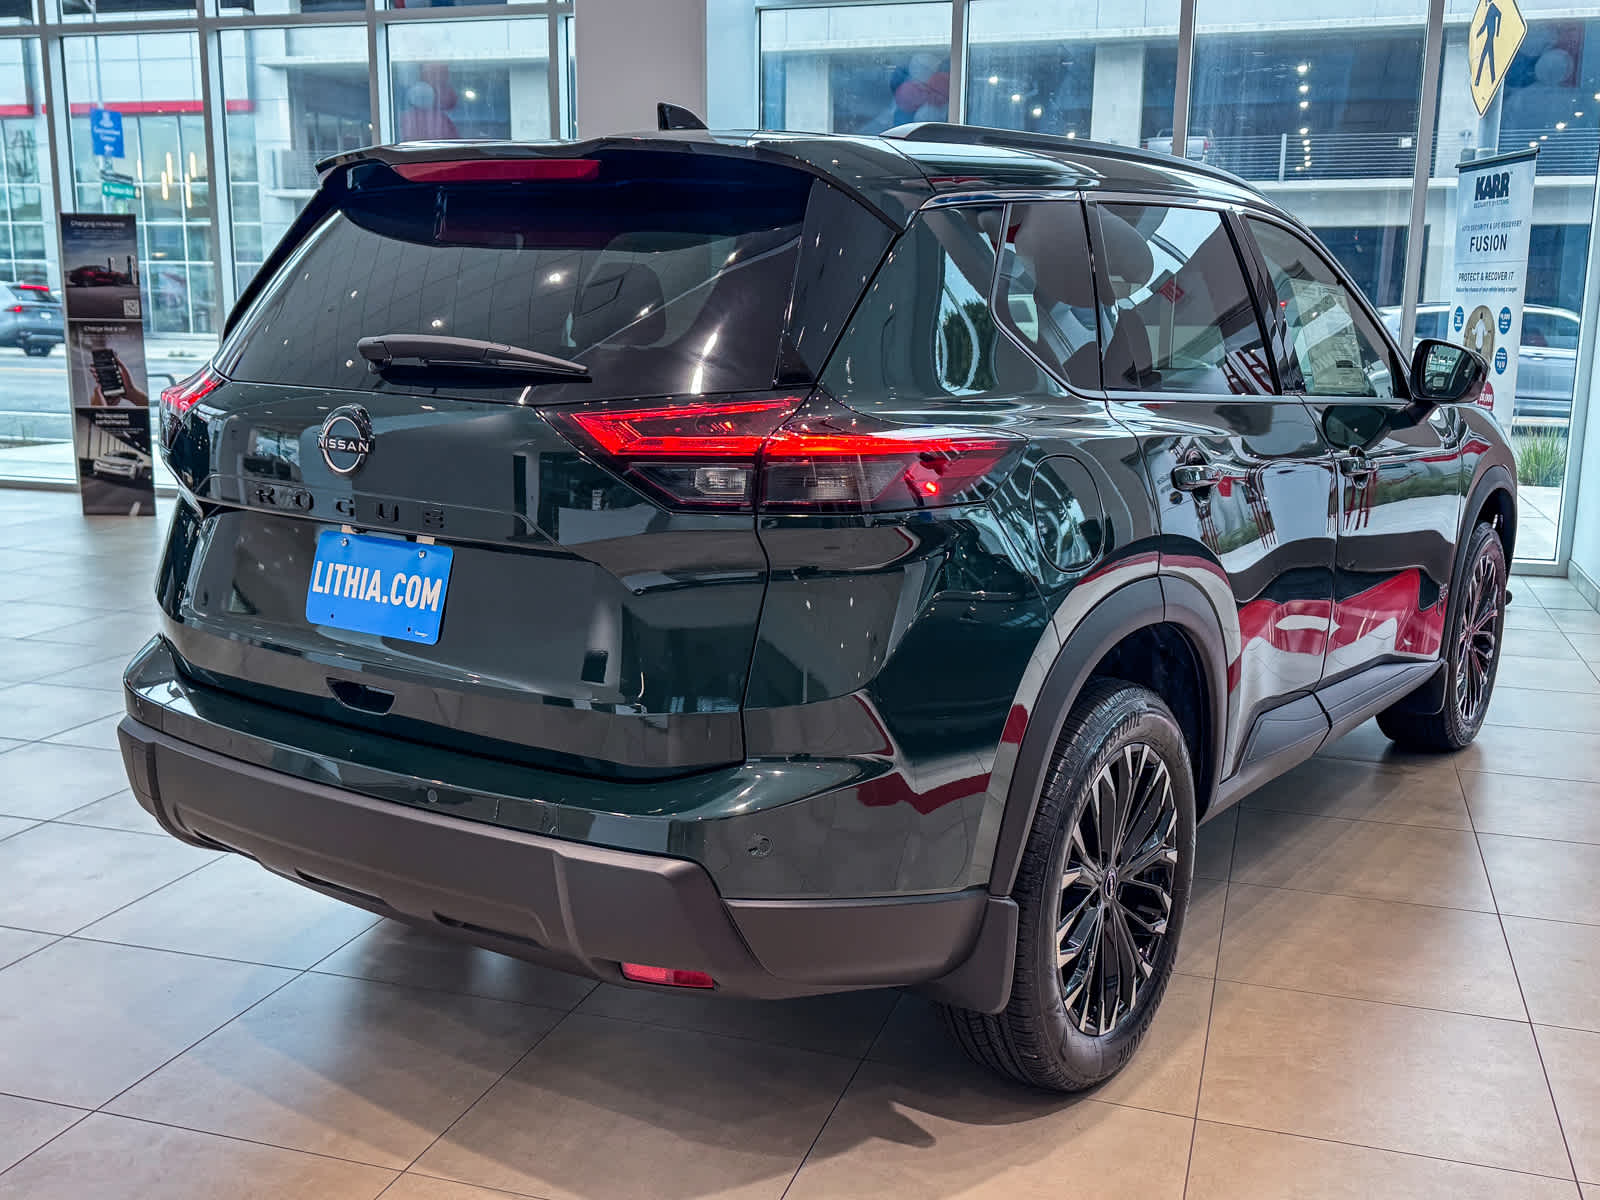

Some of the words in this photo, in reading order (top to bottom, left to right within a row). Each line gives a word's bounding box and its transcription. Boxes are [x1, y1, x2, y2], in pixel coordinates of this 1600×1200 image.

[1474, 172, 1510, 201] KARR
[1500, 220, 1522, 229] RECOVERY
[1469, 233, 1508, 252] FUSION
[1458, 272, 1479, 282] PROTECT
[1485, 271, 1508, 281] RECOVER
[1508, 271, 1515, 281] IT
[317, 438, 370, 453] NISSAN
[255, 486, 445, 529] ROGUE
[312, 561, 443, 612] LITHIA.COM
